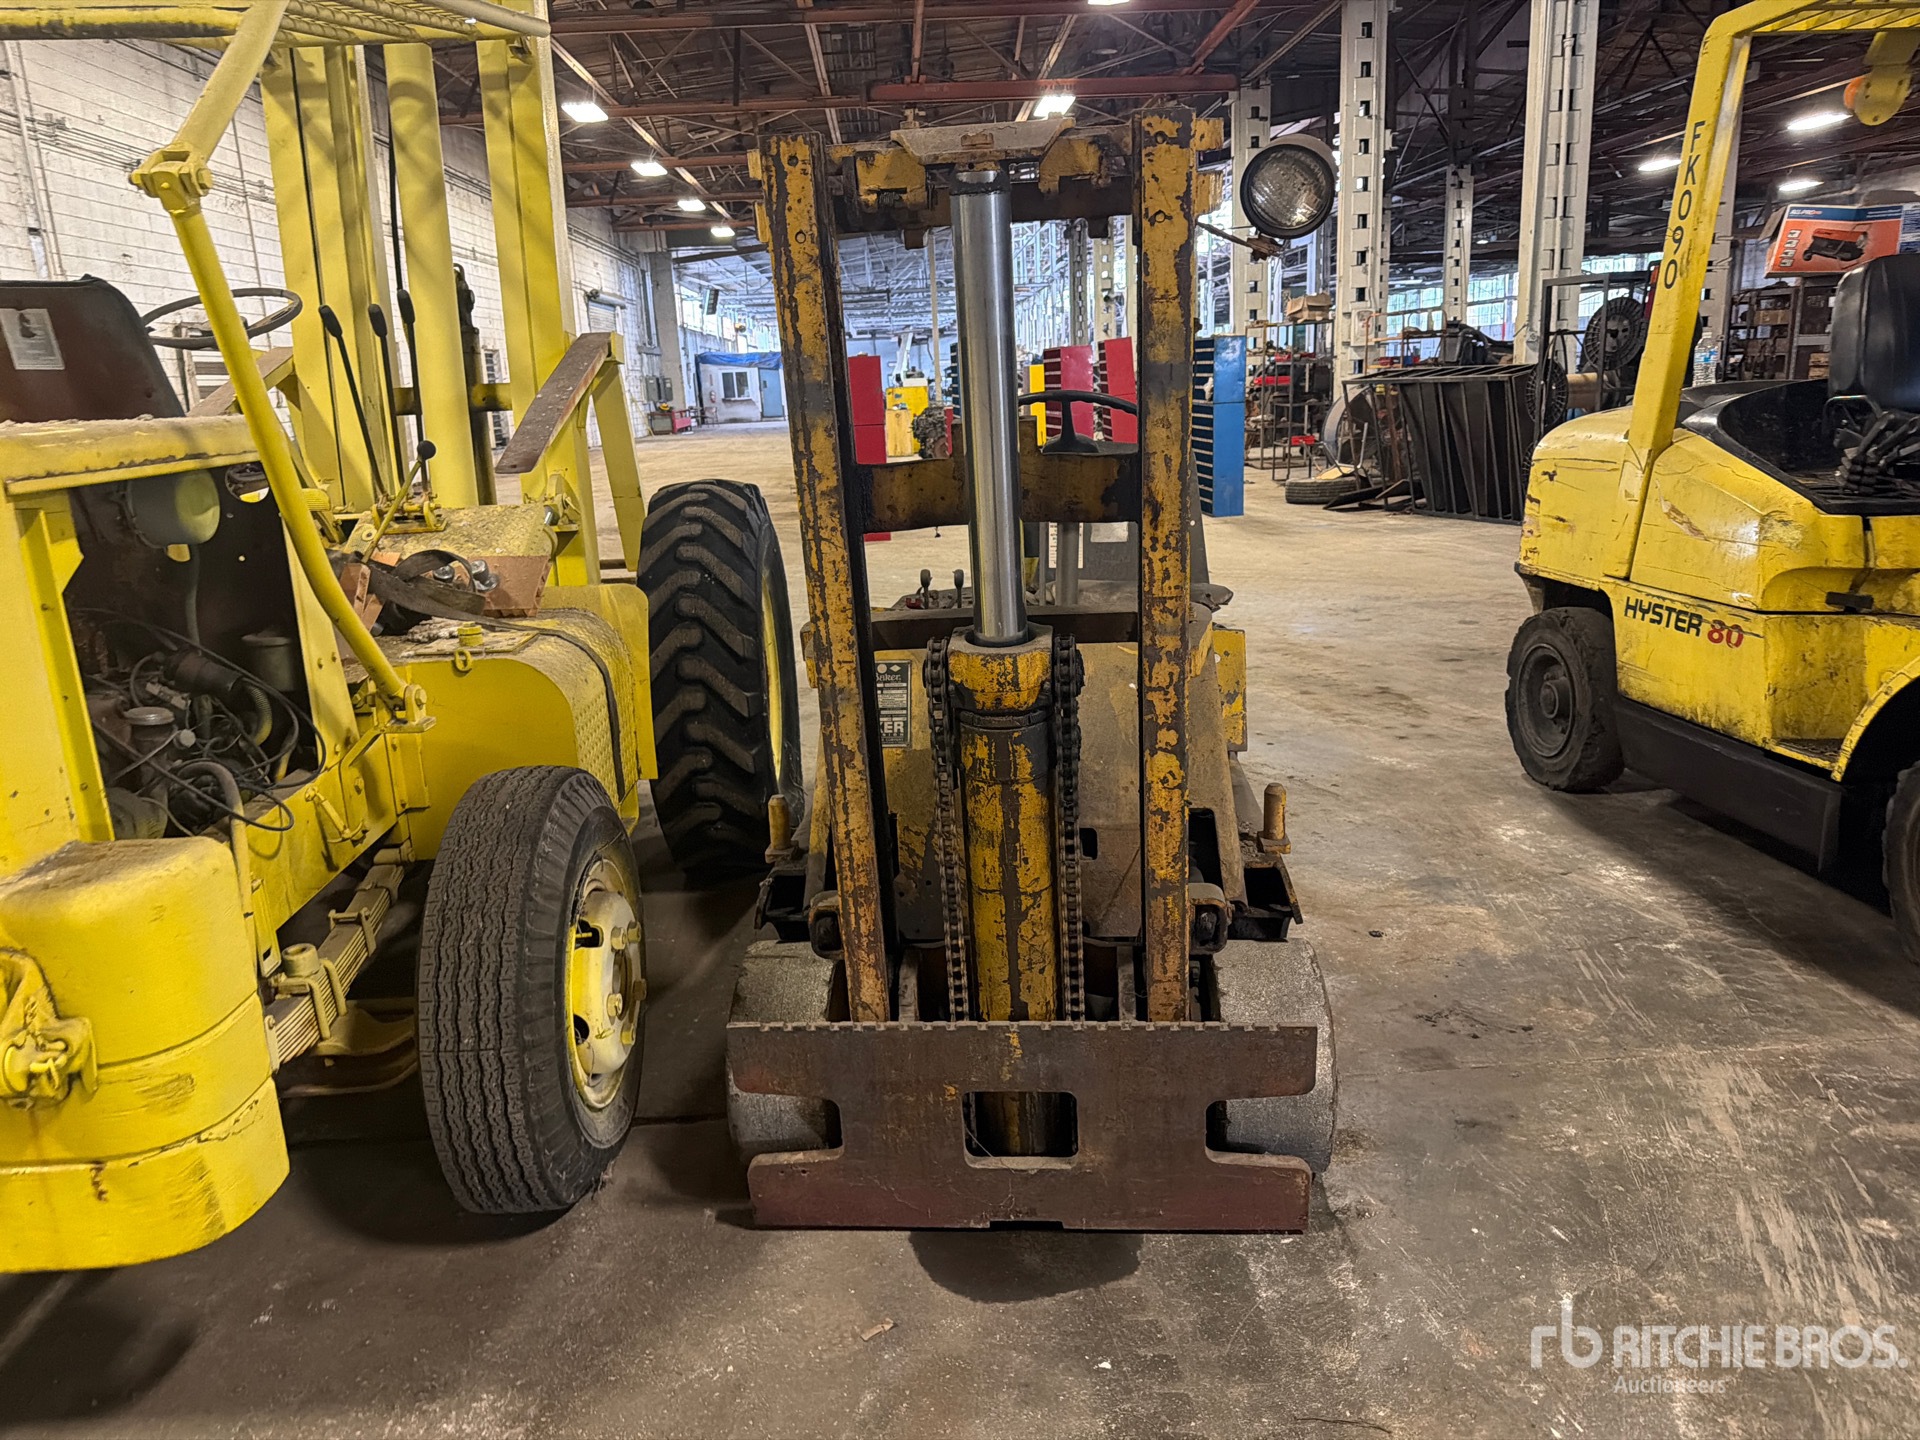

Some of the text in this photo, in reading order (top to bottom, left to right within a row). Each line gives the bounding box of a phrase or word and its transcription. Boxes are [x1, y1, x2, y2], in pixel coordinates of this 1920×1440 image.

[1664, 120, 1706, 289] FK090
[1624, 596, 1744, 648] HYSTER 80
